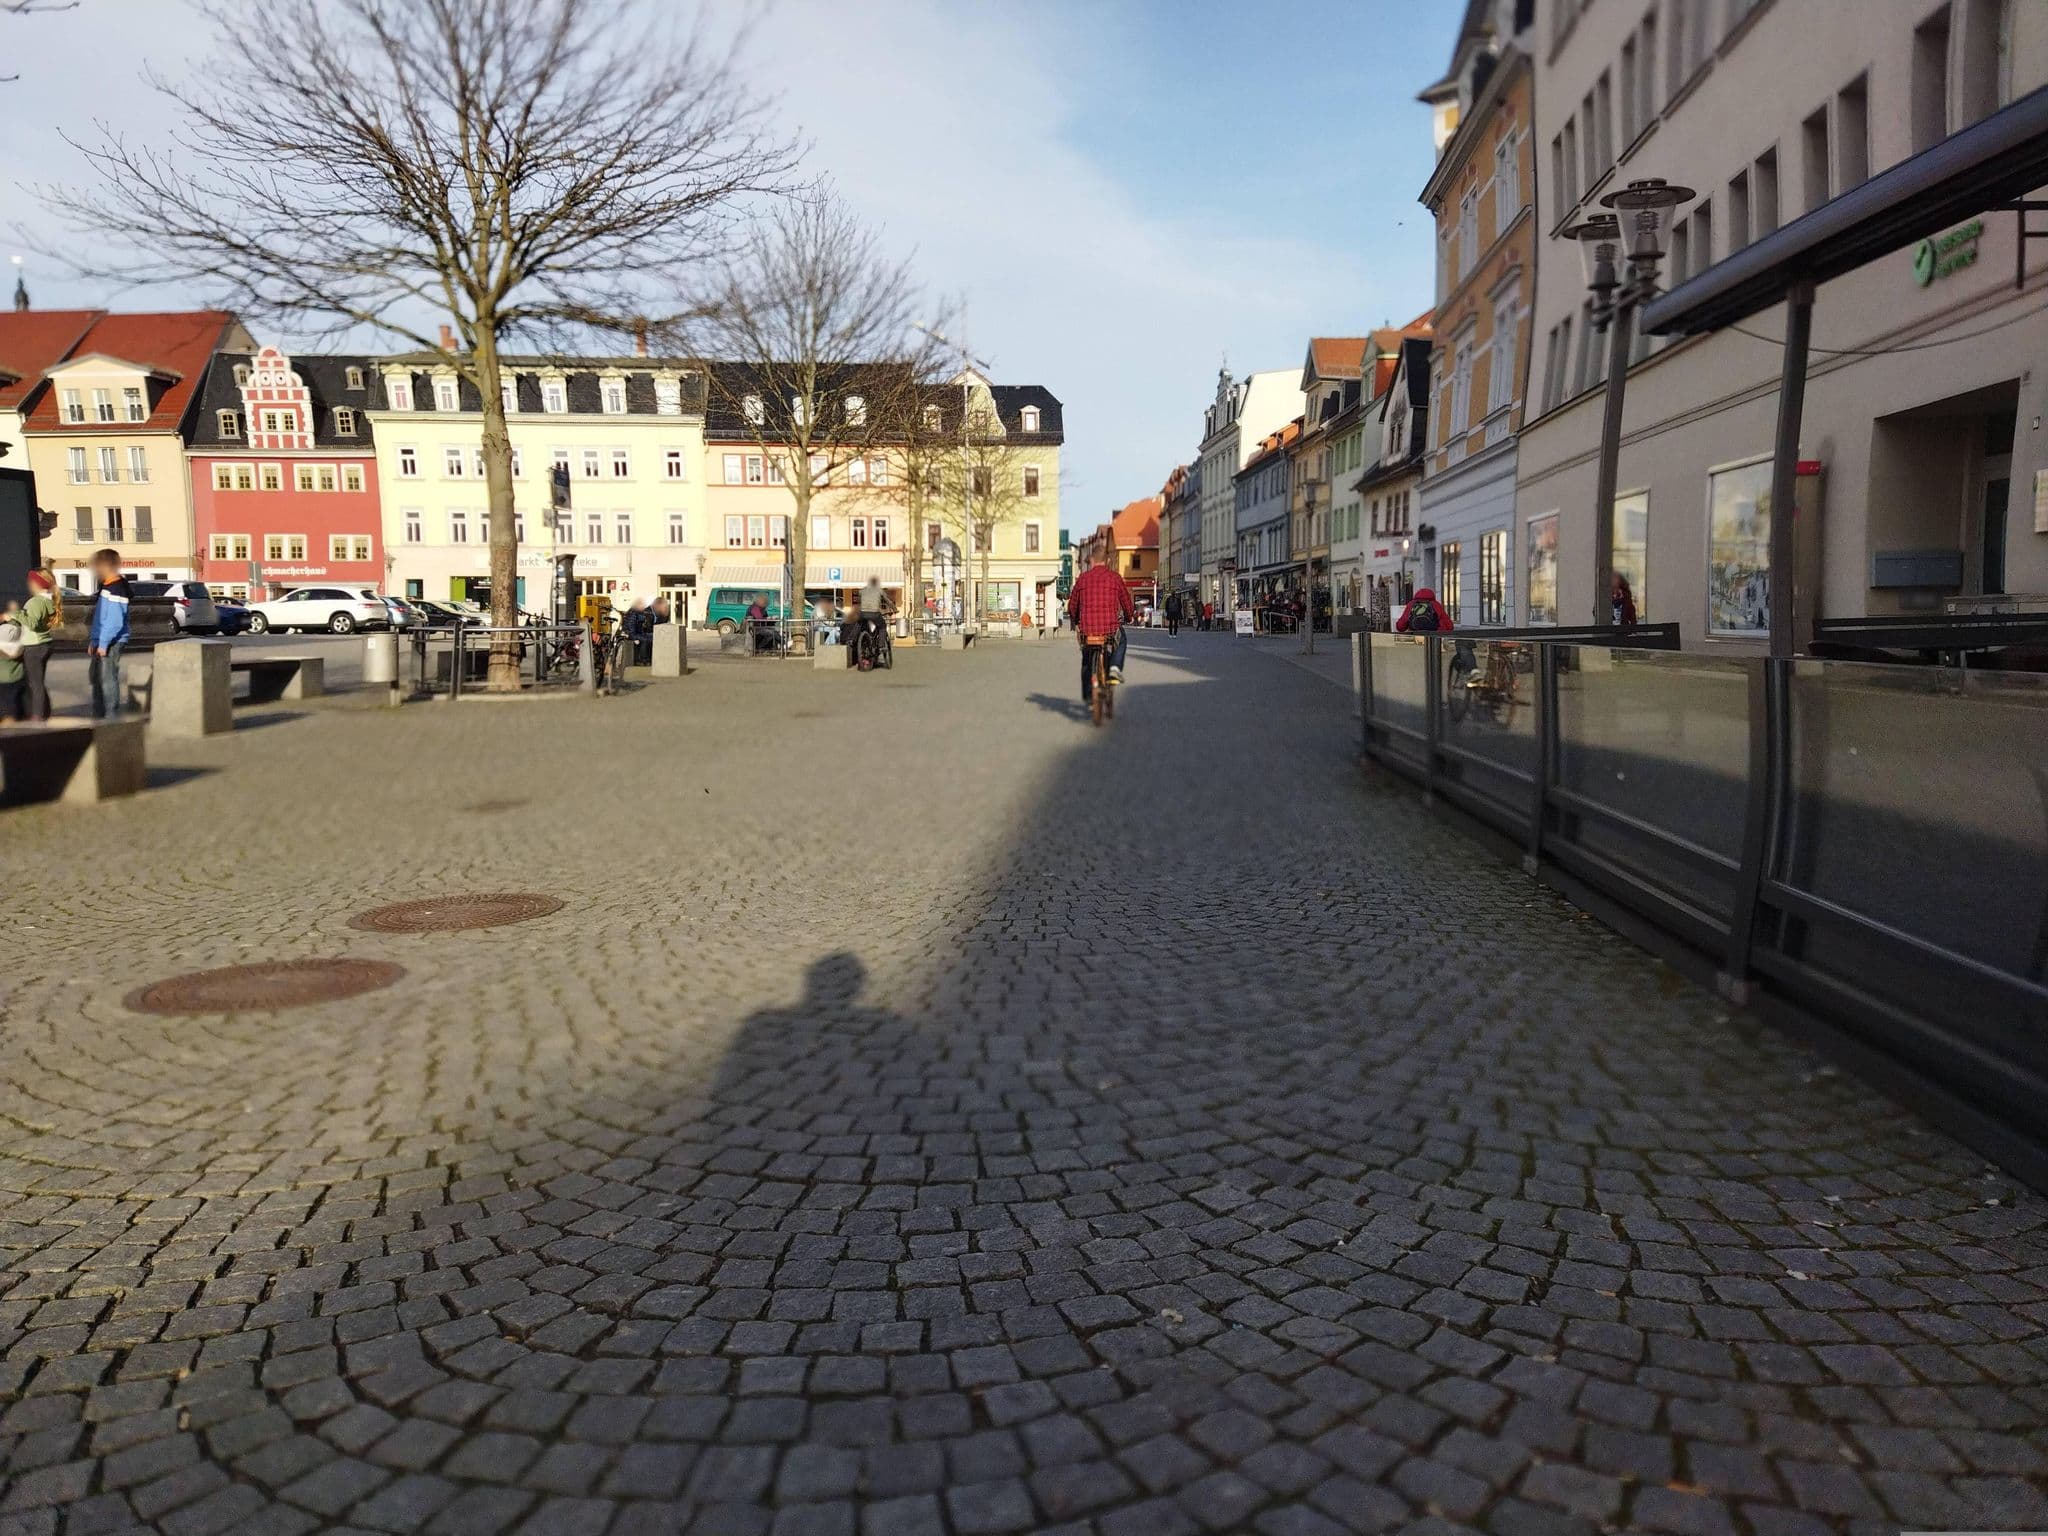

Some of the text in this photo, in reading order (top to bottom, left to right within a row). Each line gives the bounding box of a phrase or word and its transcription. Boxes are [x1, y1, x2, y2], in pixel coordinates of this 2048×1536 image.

[120, 559, 155, 568] rmation
[519, 557, 541, 567] arkt
[261, 566, 327, 576] chmacherhaus
